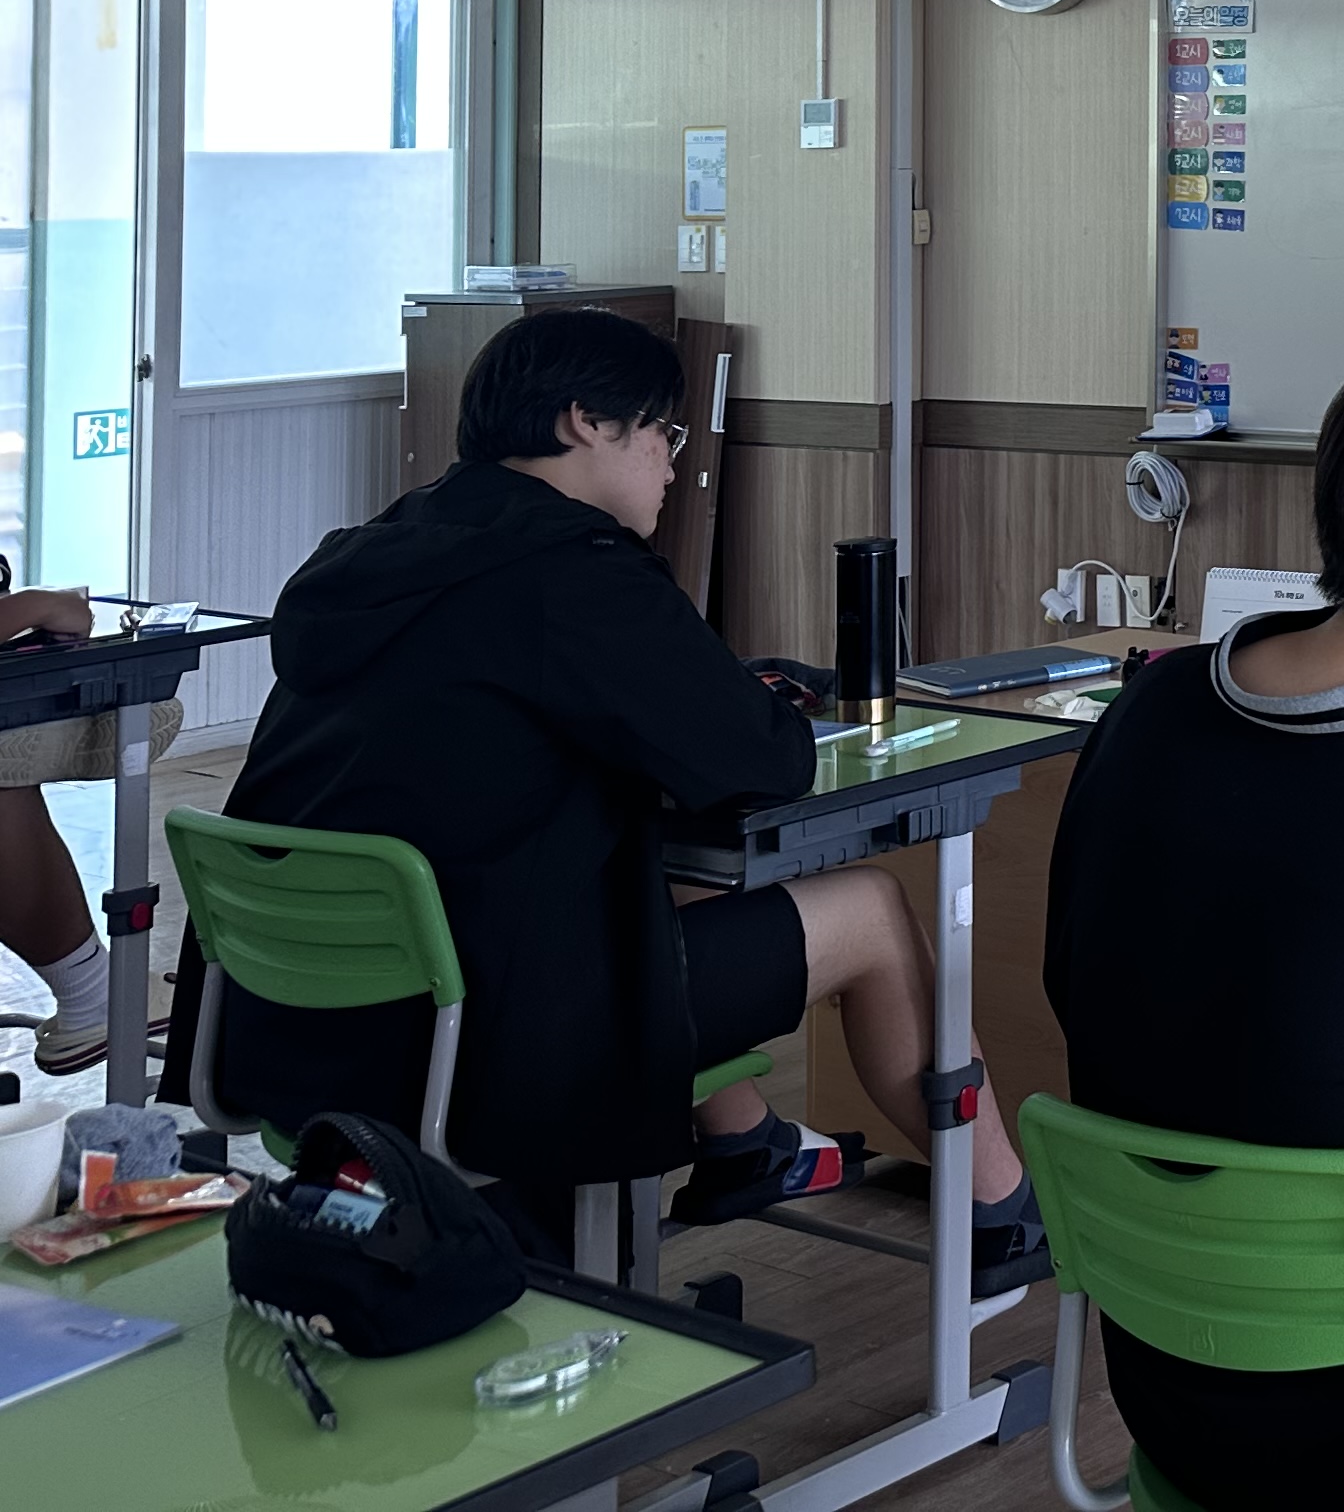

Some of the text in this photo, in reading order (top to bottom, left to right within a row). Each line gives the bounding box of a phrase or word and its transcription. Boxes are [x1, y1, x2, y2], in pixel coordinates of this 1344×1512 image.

[1175, 44, 1201, 58] 1교시
[1175, 71, 1201, 85] 2교시
[1174, 154, 1201, 168] 5교시
[1175, 208, 1201, 223] 7교시
